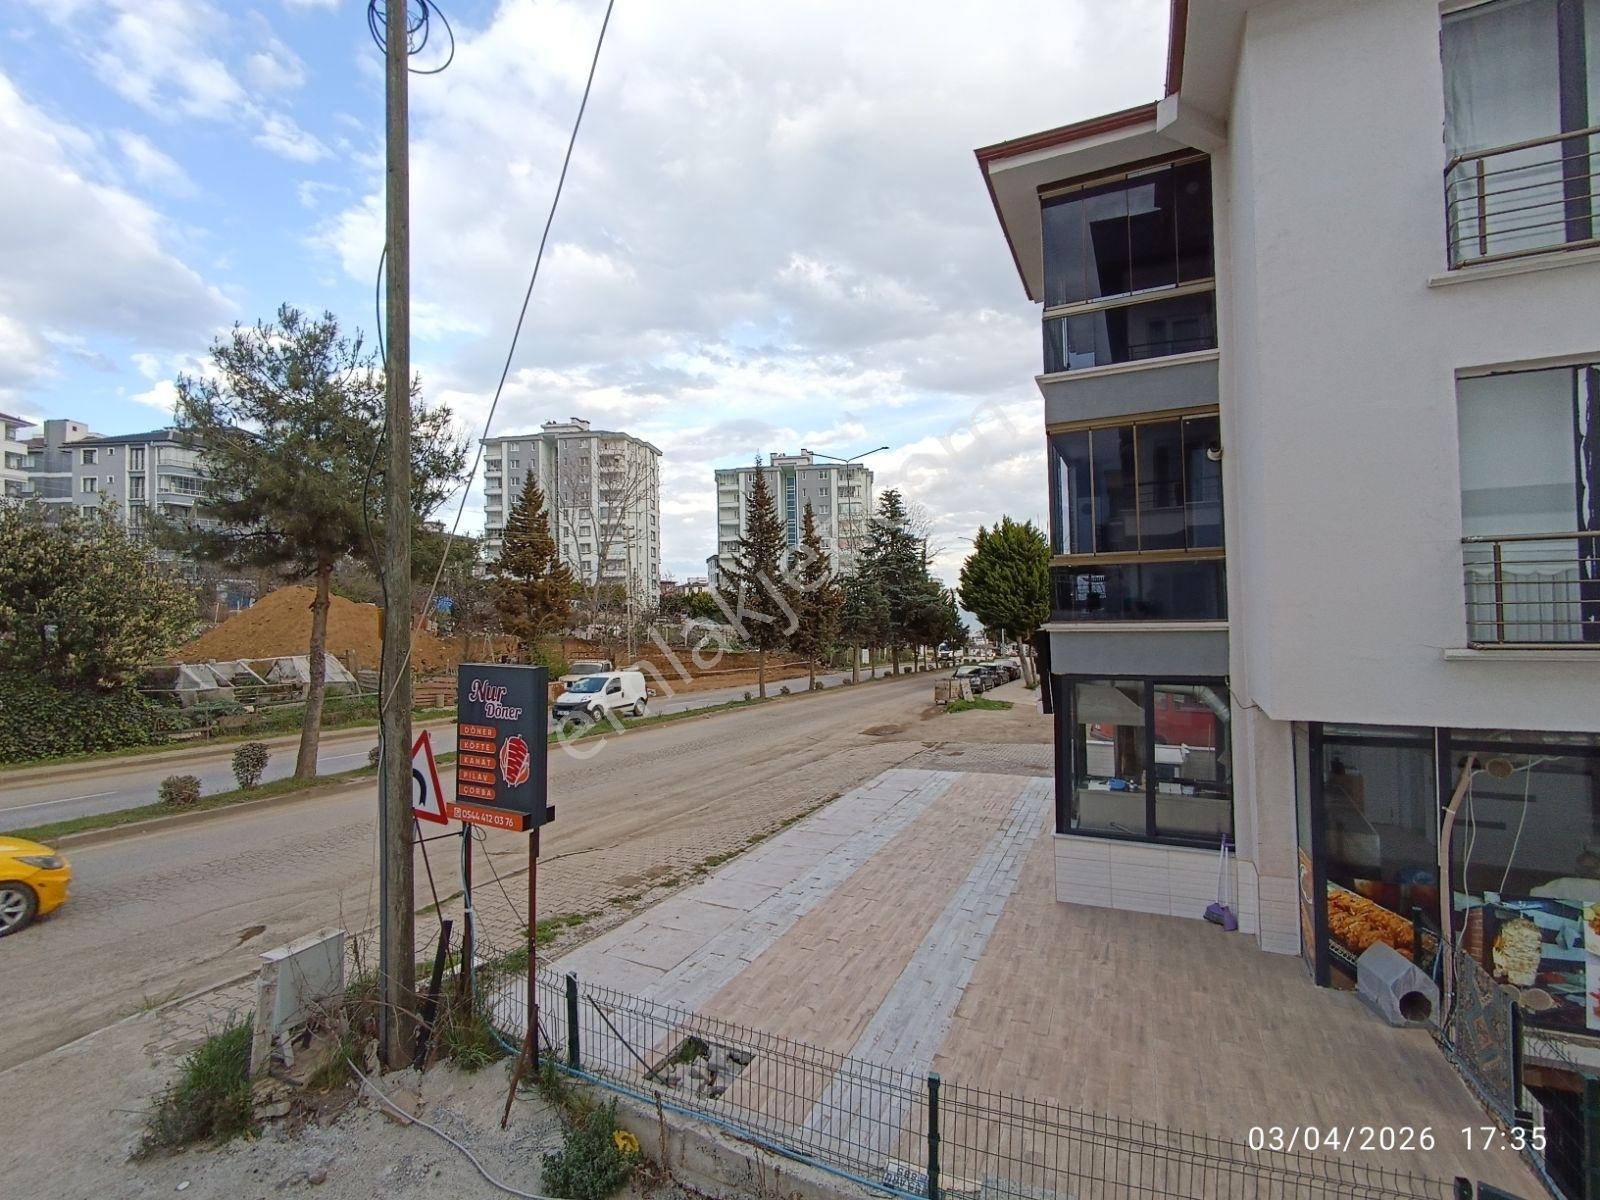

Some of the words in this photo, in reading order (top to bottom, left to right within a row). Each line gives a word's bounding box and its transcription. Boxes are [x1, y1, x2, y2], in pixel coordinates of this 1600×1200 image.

[468, 678, 507, 703] Nur
[484, 702, 523, 721] Döner
[463, 756, 492, 767] KANAT
[462, 809, 480, 821] 0544
[481, 813, 493, 824] 412
[494, 815, 504, 825] 03
[505, 817, 514, 827] 76
